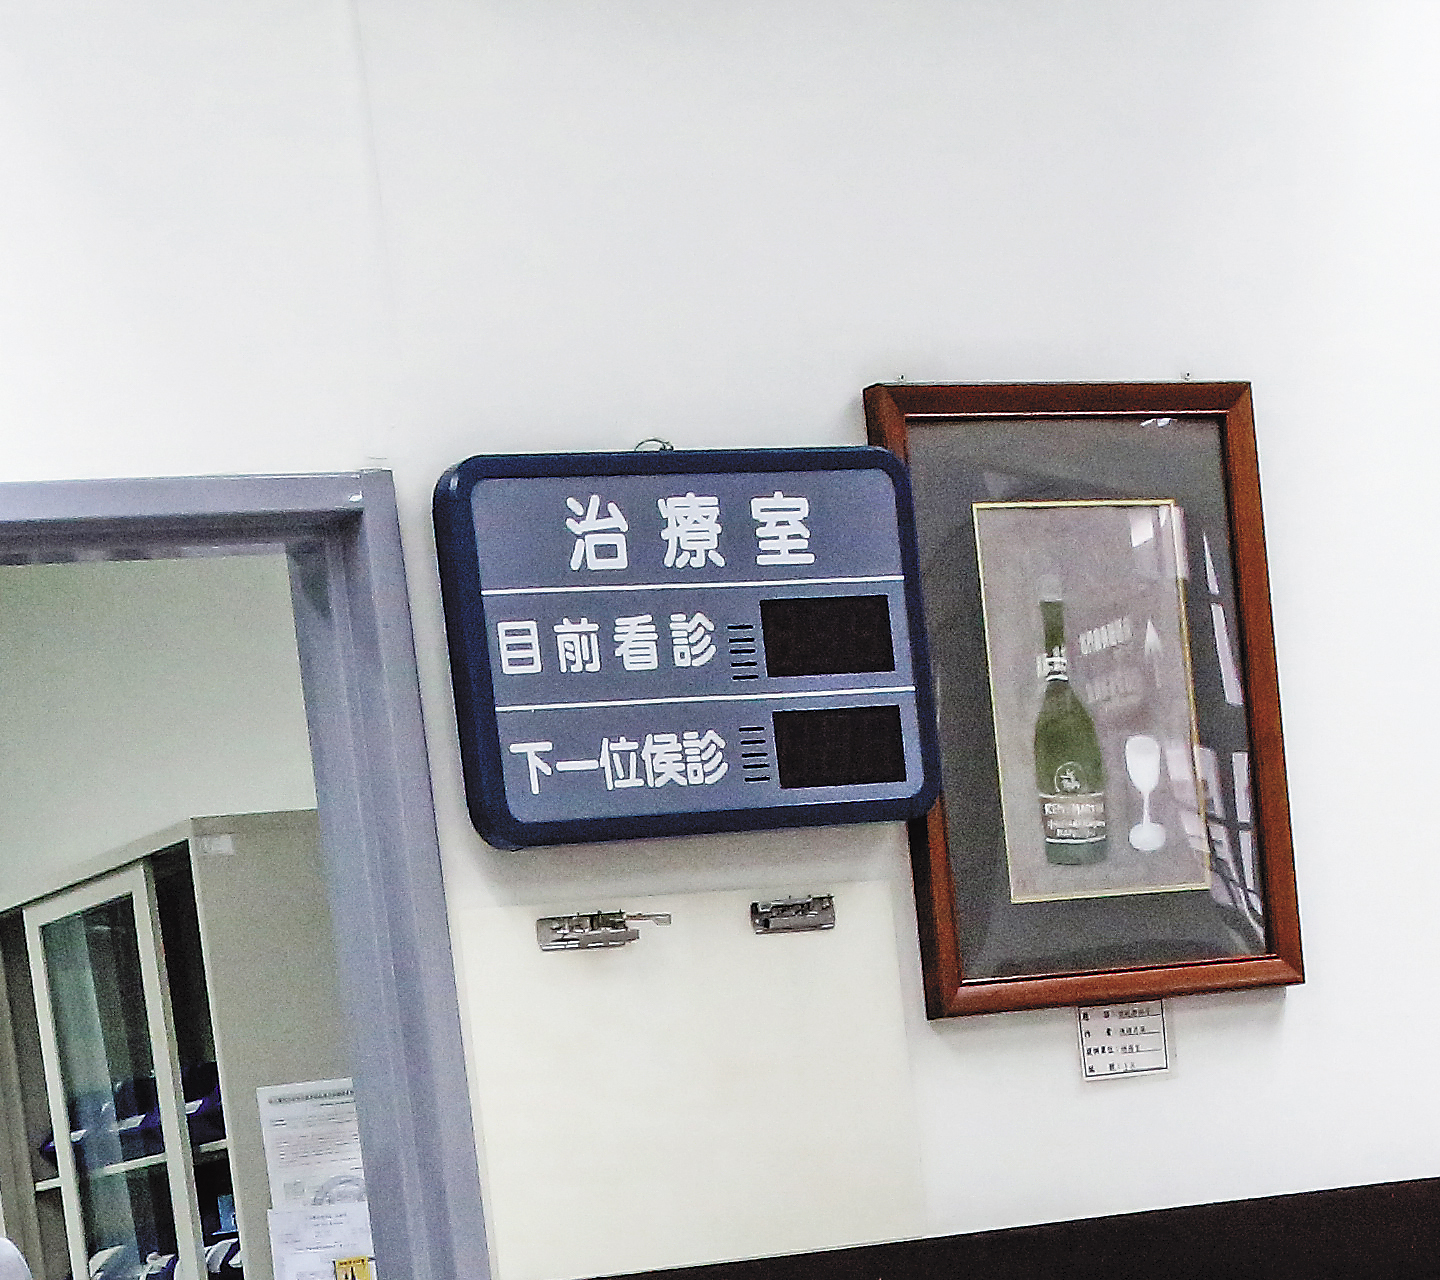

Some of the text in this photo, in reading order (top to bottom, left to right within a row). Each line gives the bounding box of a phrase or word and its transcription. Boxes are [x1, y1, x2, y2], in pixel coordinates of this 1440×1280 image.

[565, 492, 818, 571] 治療室
[496, 611, 717, 676] 目前看診
